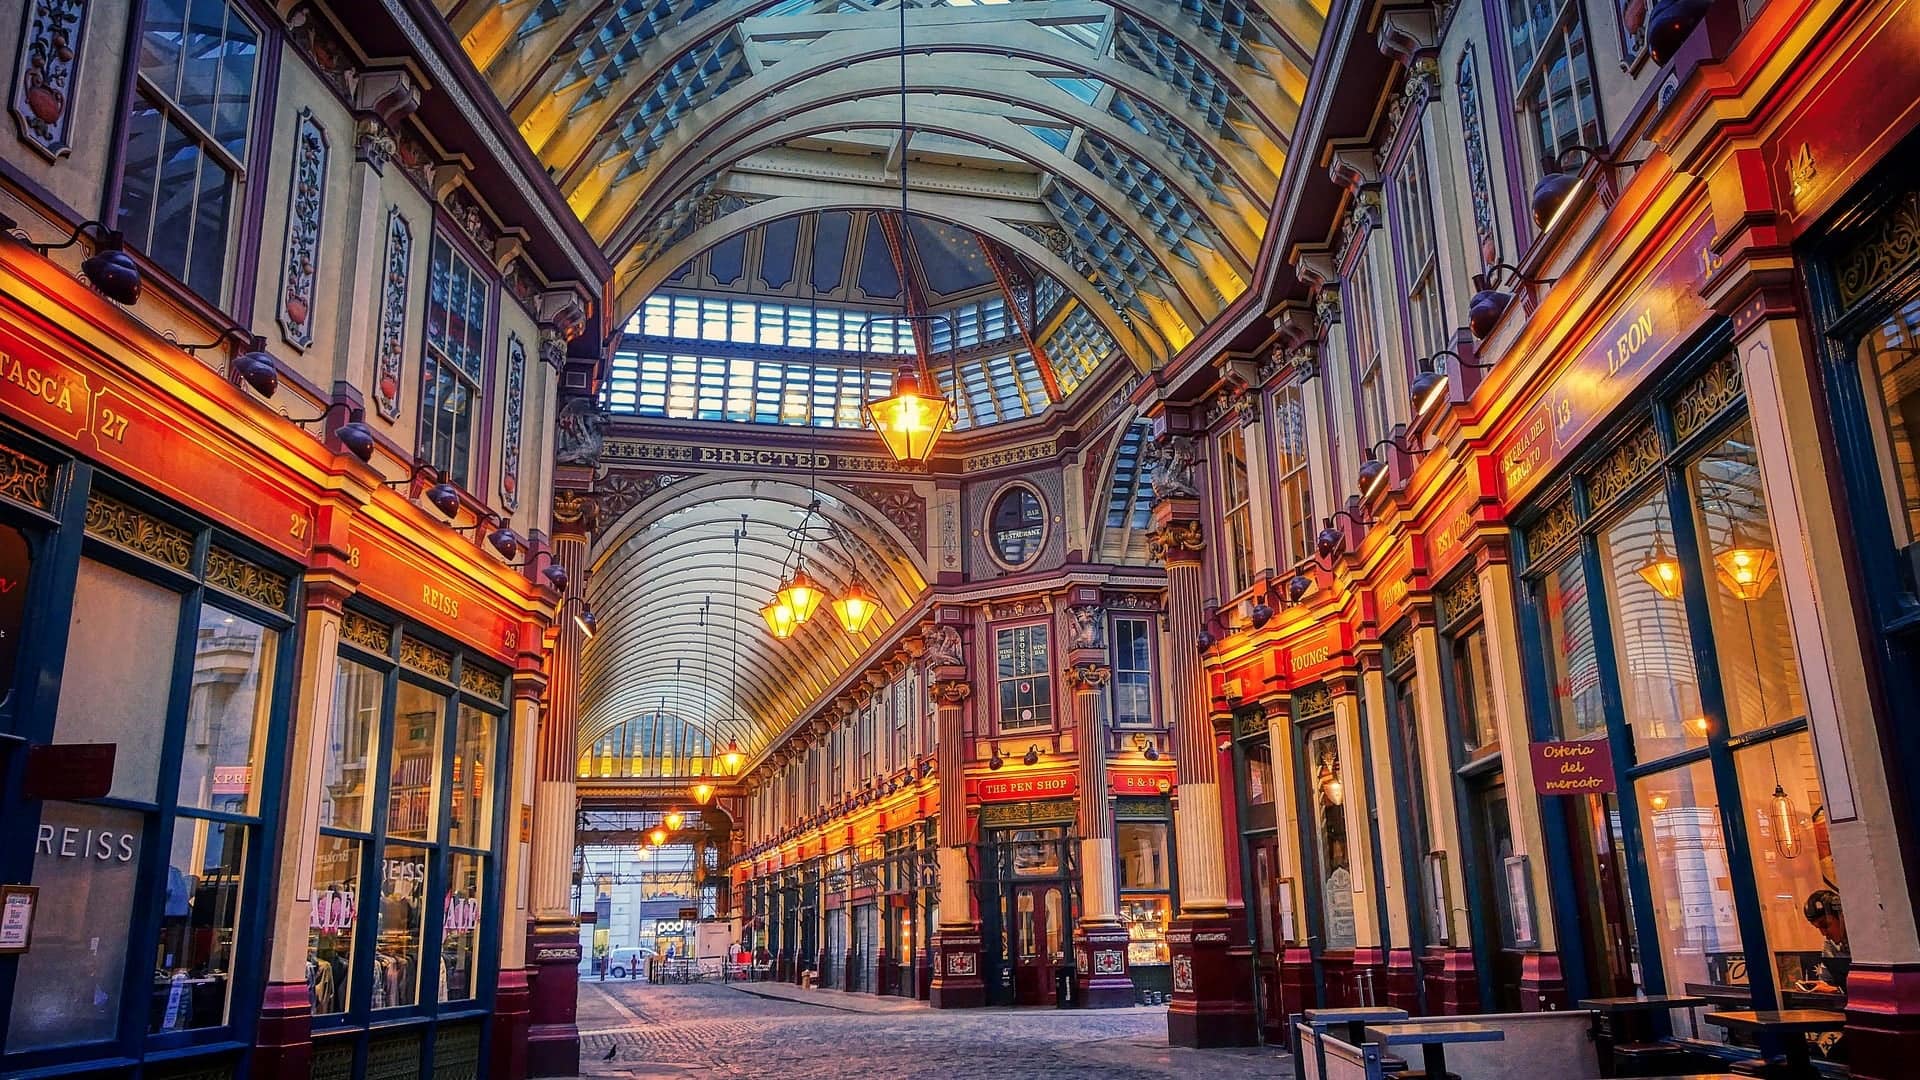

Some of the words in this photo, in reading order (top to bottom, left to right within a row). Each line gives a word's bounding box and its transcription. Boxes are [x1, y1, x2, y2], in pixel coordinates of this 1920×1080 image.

[1784, 142, 1816, 196] 14
[1606, 307, 1654, 378] LEON
[0, 351, 73, 415] TASCA
[101, 408, 129, 442] 27
[1557, 399, 1571, 430] 13
[699, 447, 831, 470] ERECTED
[1500, 433, 1531, 475] OSTERIA
[1530, 416, 1547, 442] DEL
[1506, 446, 1541, 490] MERCATO
[290, 512, 308, 541] 27
[1000, 528, 1041, 541] RESTAURANT
[422, 583, 460, 620] REISS
[504, 630, 516, 649] 26
[1290, 645, 1330, 674] YOUNGS
[1543, 743, 1595, 758] Osteria
[1127, 777, 1133, 787] 8
[1136, 777, 1146, 787] &
[1560, 761, 1585, 774] del
[986, 784, 1007, 795] THE
[1010, 781, 1033, 792] PEN
[1037, 779, 1067, 790] SHOP
[1545, 776, 1604, 790] mercato
[34, 823, 135, 862] REISS
[657, 919, 684, 935] pod
